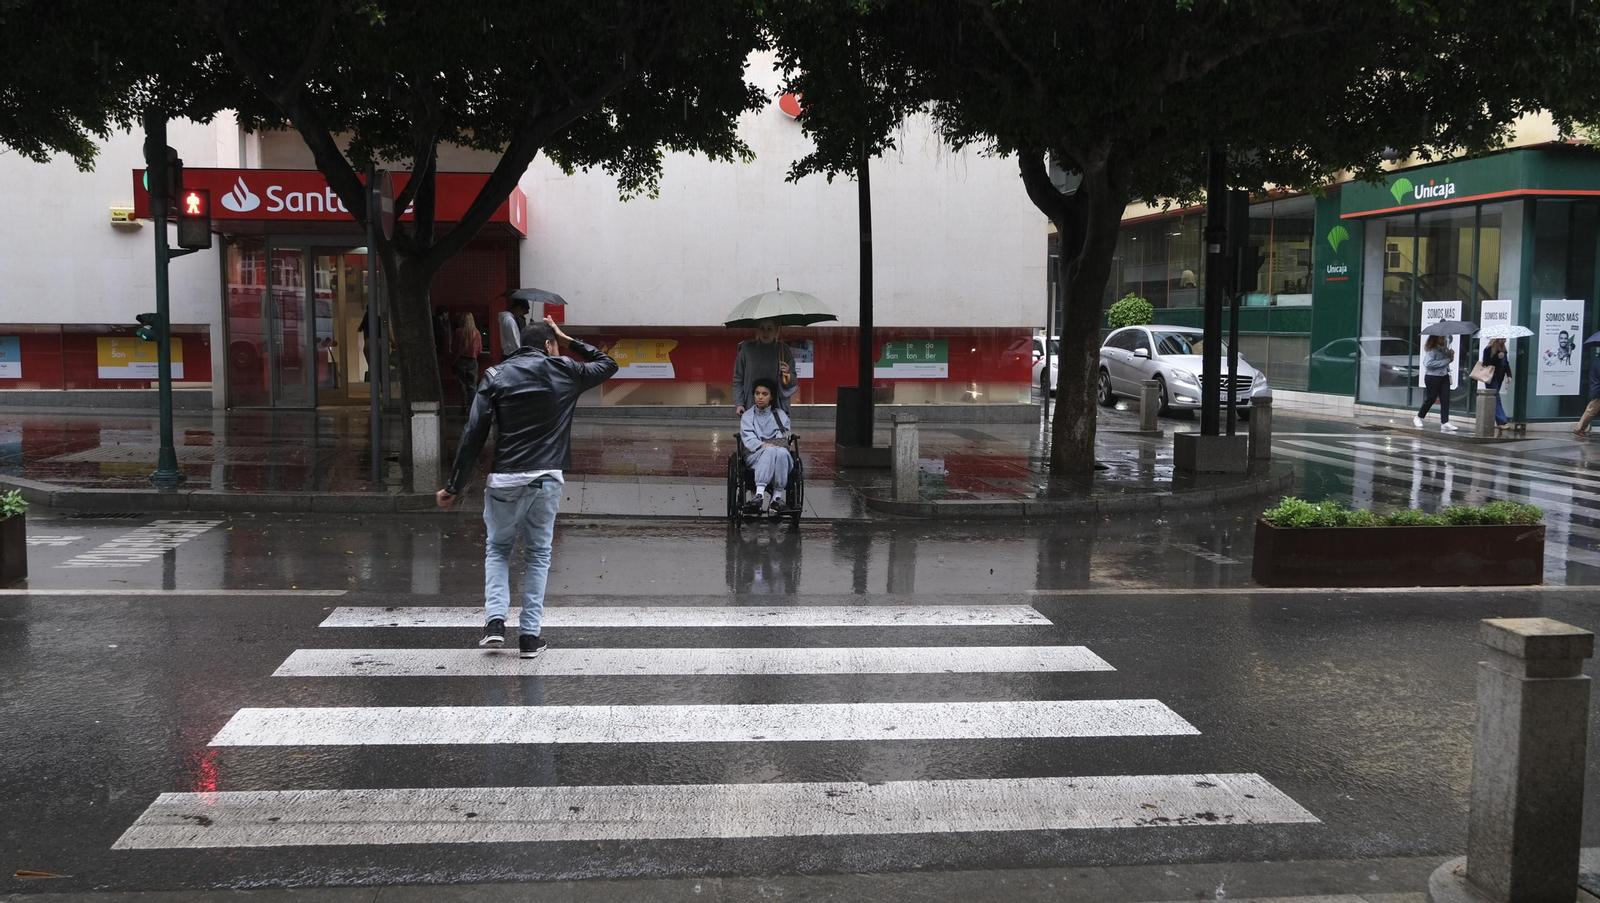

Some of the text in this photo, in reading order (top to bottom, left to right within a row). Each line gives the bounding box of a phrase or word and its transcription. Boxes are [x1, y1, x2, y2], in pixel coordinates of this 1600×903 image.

[1414, 177, 1455, 200] Unicaja
[1326, 262, 1347, 274] Unicaja
[1427, 306, 1456, 319] SOMOS MÁS
[1484, 310, 1508, 320] SOMOS MÁS
[1545, 310, 1579, 322] SOMOS MÁS
